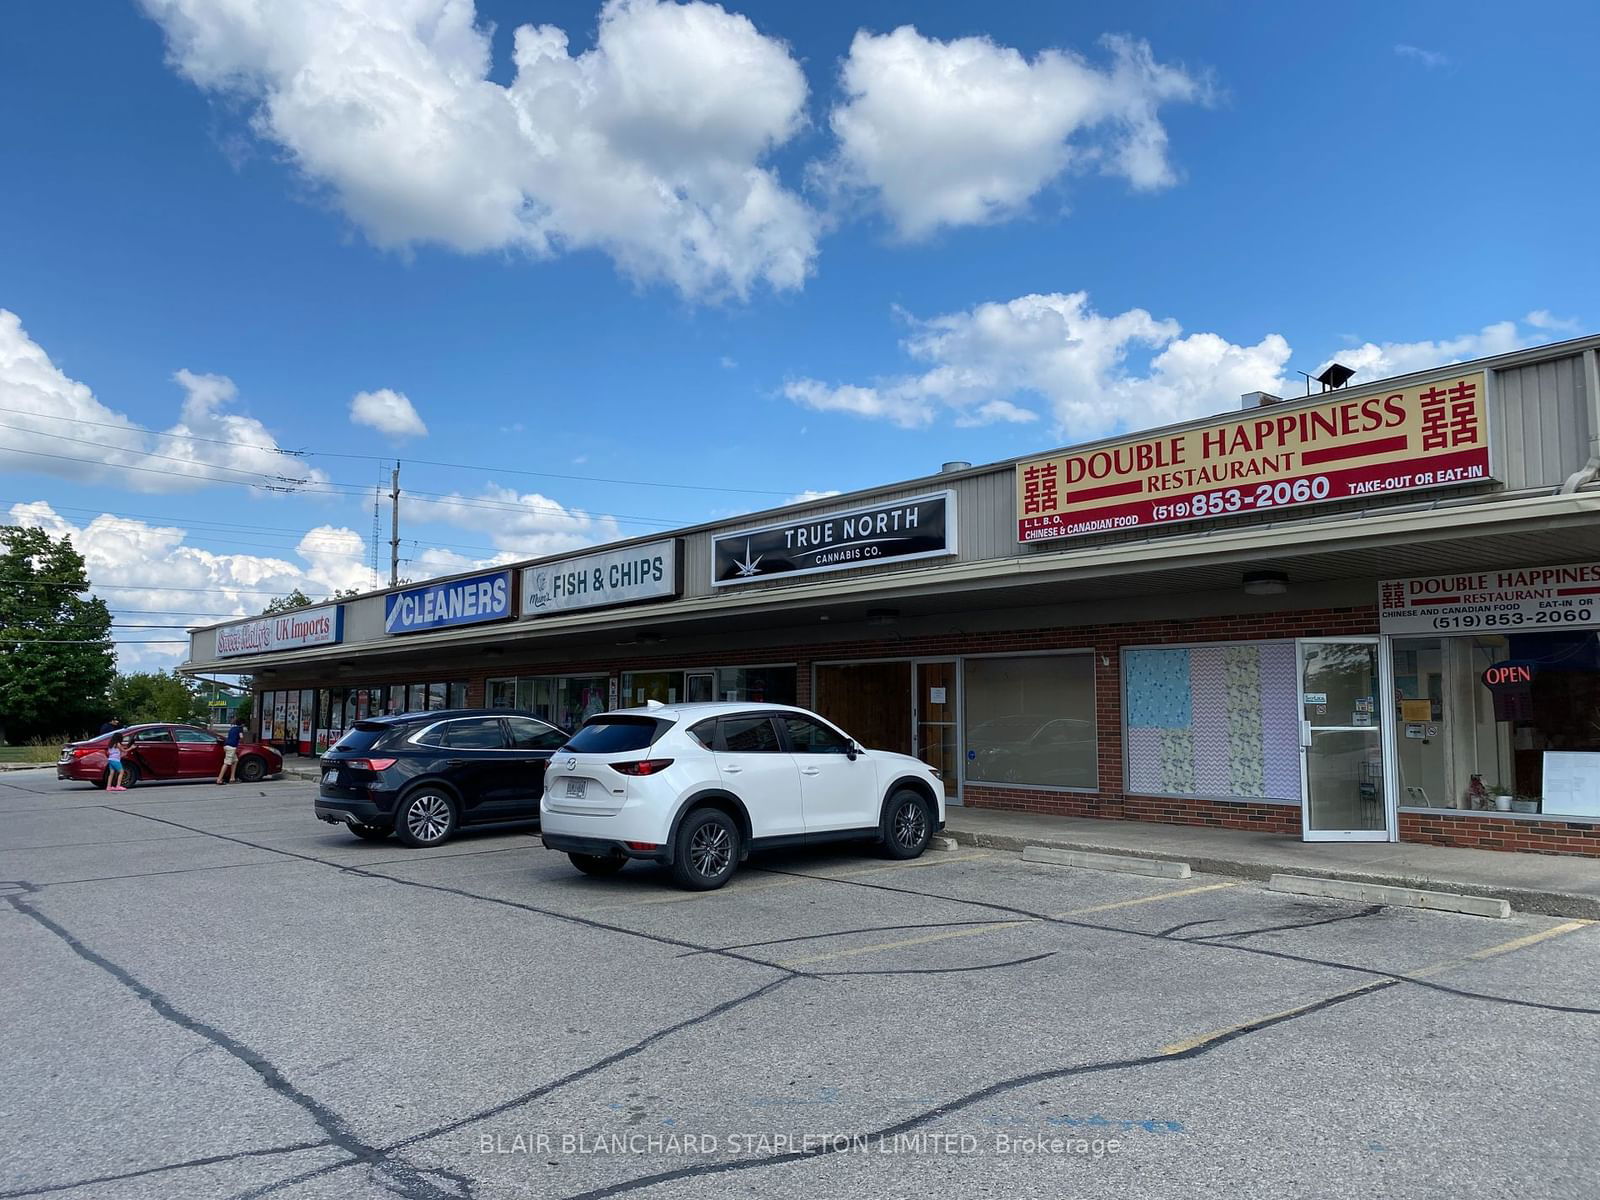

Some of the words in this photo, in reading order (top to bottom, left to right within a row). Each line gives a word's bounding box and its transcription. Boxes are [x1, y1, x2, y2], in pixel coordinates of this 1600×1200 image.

[1066, 436, 1185, 484] DOUBLE
[1203, 394, 1406, 459] HAPPINESS
[1148, 452, 1295, 493] RESTAURANT
[1348, 475, 1412, 494] TAKE-OUT
[1415, 472, 1433, 485] OR
[1437, 465, 1482, 482] EAT-IN
[785, 523, 833, 549] TRUE
[843, 507, 918, 539] NORTH
[1025, 526, 1058, 540] CHINESE
[1060, 525, 1065, 535] &
[1067, 519, 1112, 534] CANADIAN
[1113, 515, 1139, 528] FOOD
[815, 549, 861, 564] CANNABIS
[864, 546, 882, 557] CO.
[553, 570, 587, 597] FISH
[593, 568, 604, 591] &
[610, 556, 663, 588] CHIPS
[1410, 575, 1488, 594] DOUBLE
[402, 578, 506, 626] CLEANERS
[1382, 610, 1417, 618] CHINESE
[1420, 608, 1439, 616] AND
[1442, 604, 1490, 614] CANADIAN
[1494, 603, 1520, 611] FOOD
[1539, 599, 1573, 609] EAT-IN
[1579, 598, 1593, 606] OR
[1464, 588, 1553, 604] RESTAURANT
[276, 619, 289, 641] UK
[291, 616, 329, 643] Imports
[1487, 665, 1531, 684] OPEN
